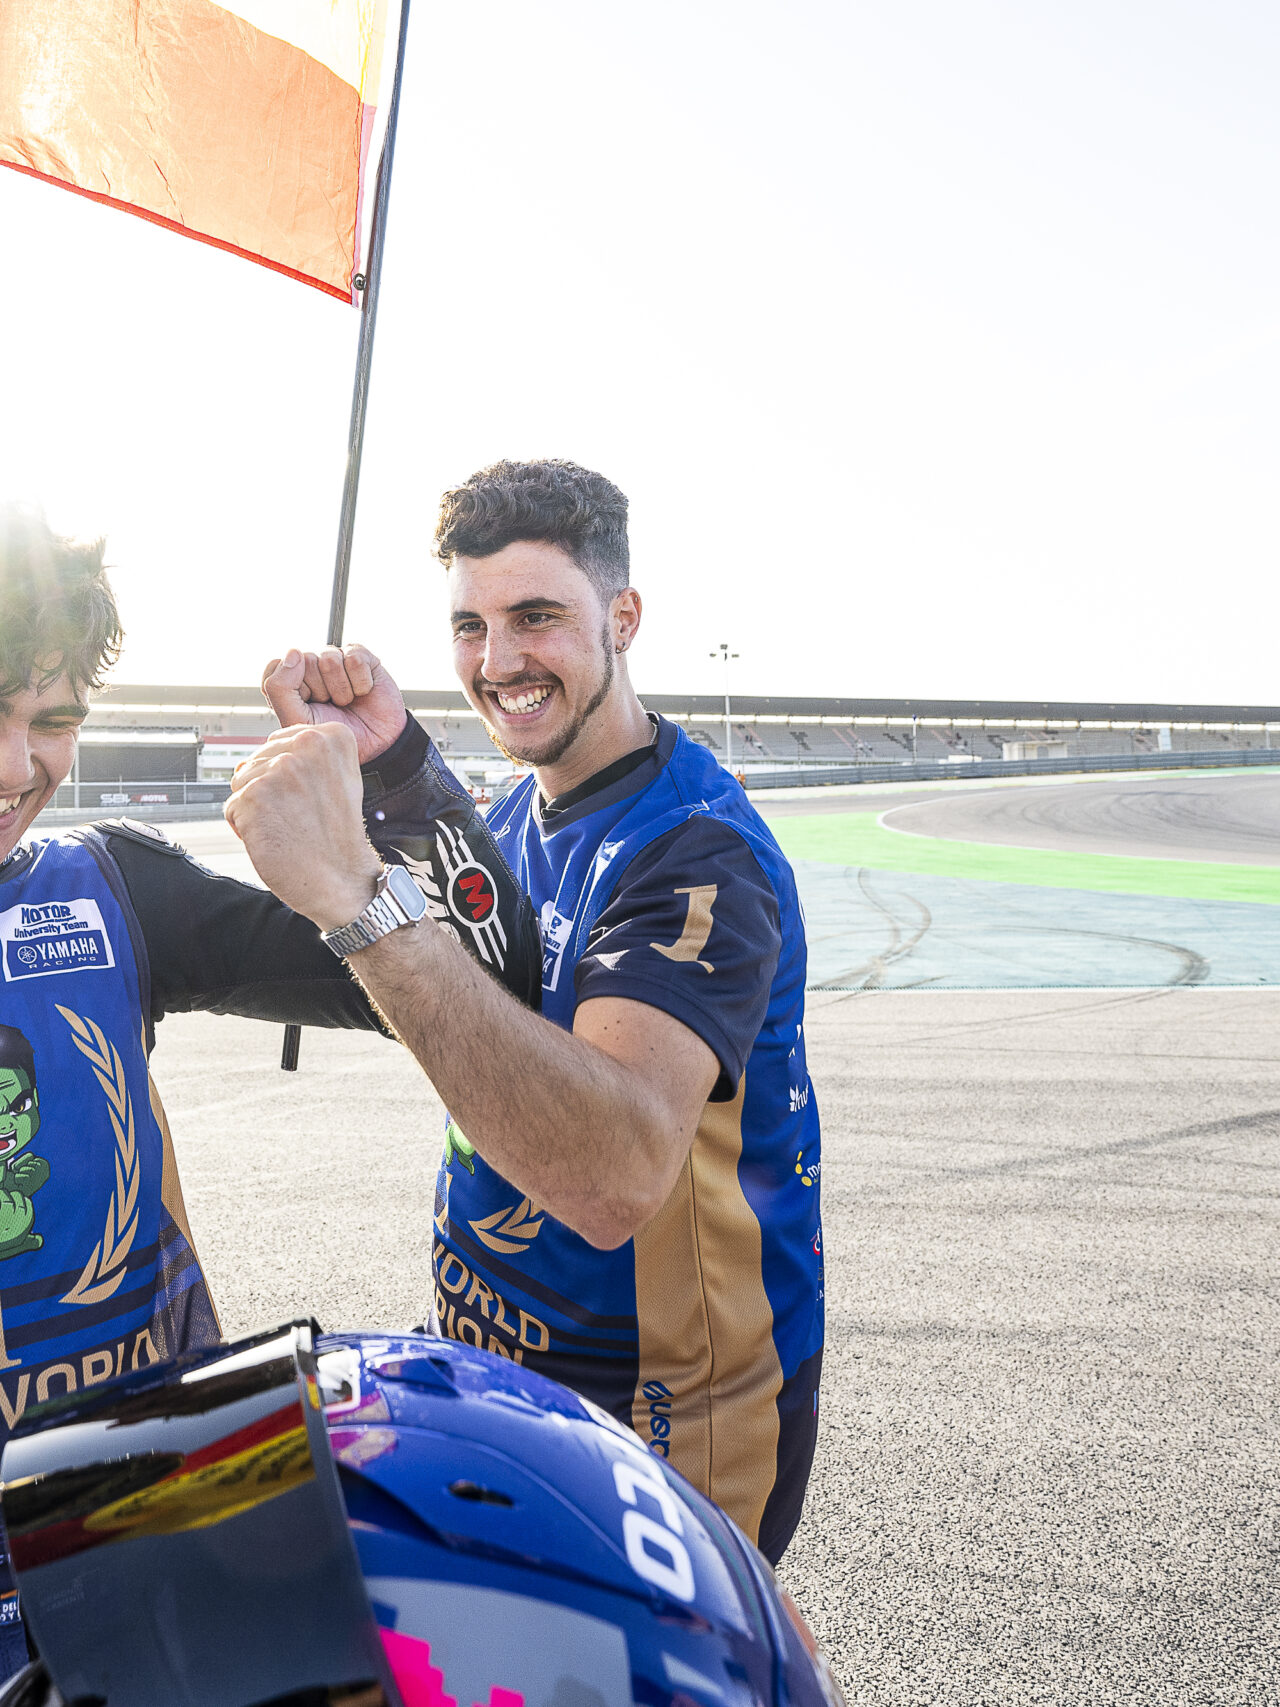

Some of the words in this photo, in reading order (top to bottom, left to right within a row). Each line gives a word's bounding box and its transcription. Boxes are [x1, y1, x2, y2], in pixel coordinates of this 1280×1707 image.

[21, 905, 72, 925] MOTOR
[14, 923, 61, 938] University
[62, 920, 89, 931] Team
[649, 884, 718, 974] 1
[35, 937, 99, 960] YAMAHA
[28, 956, 97, 969] RACING
[8, 1612, 15, 1620] Y
